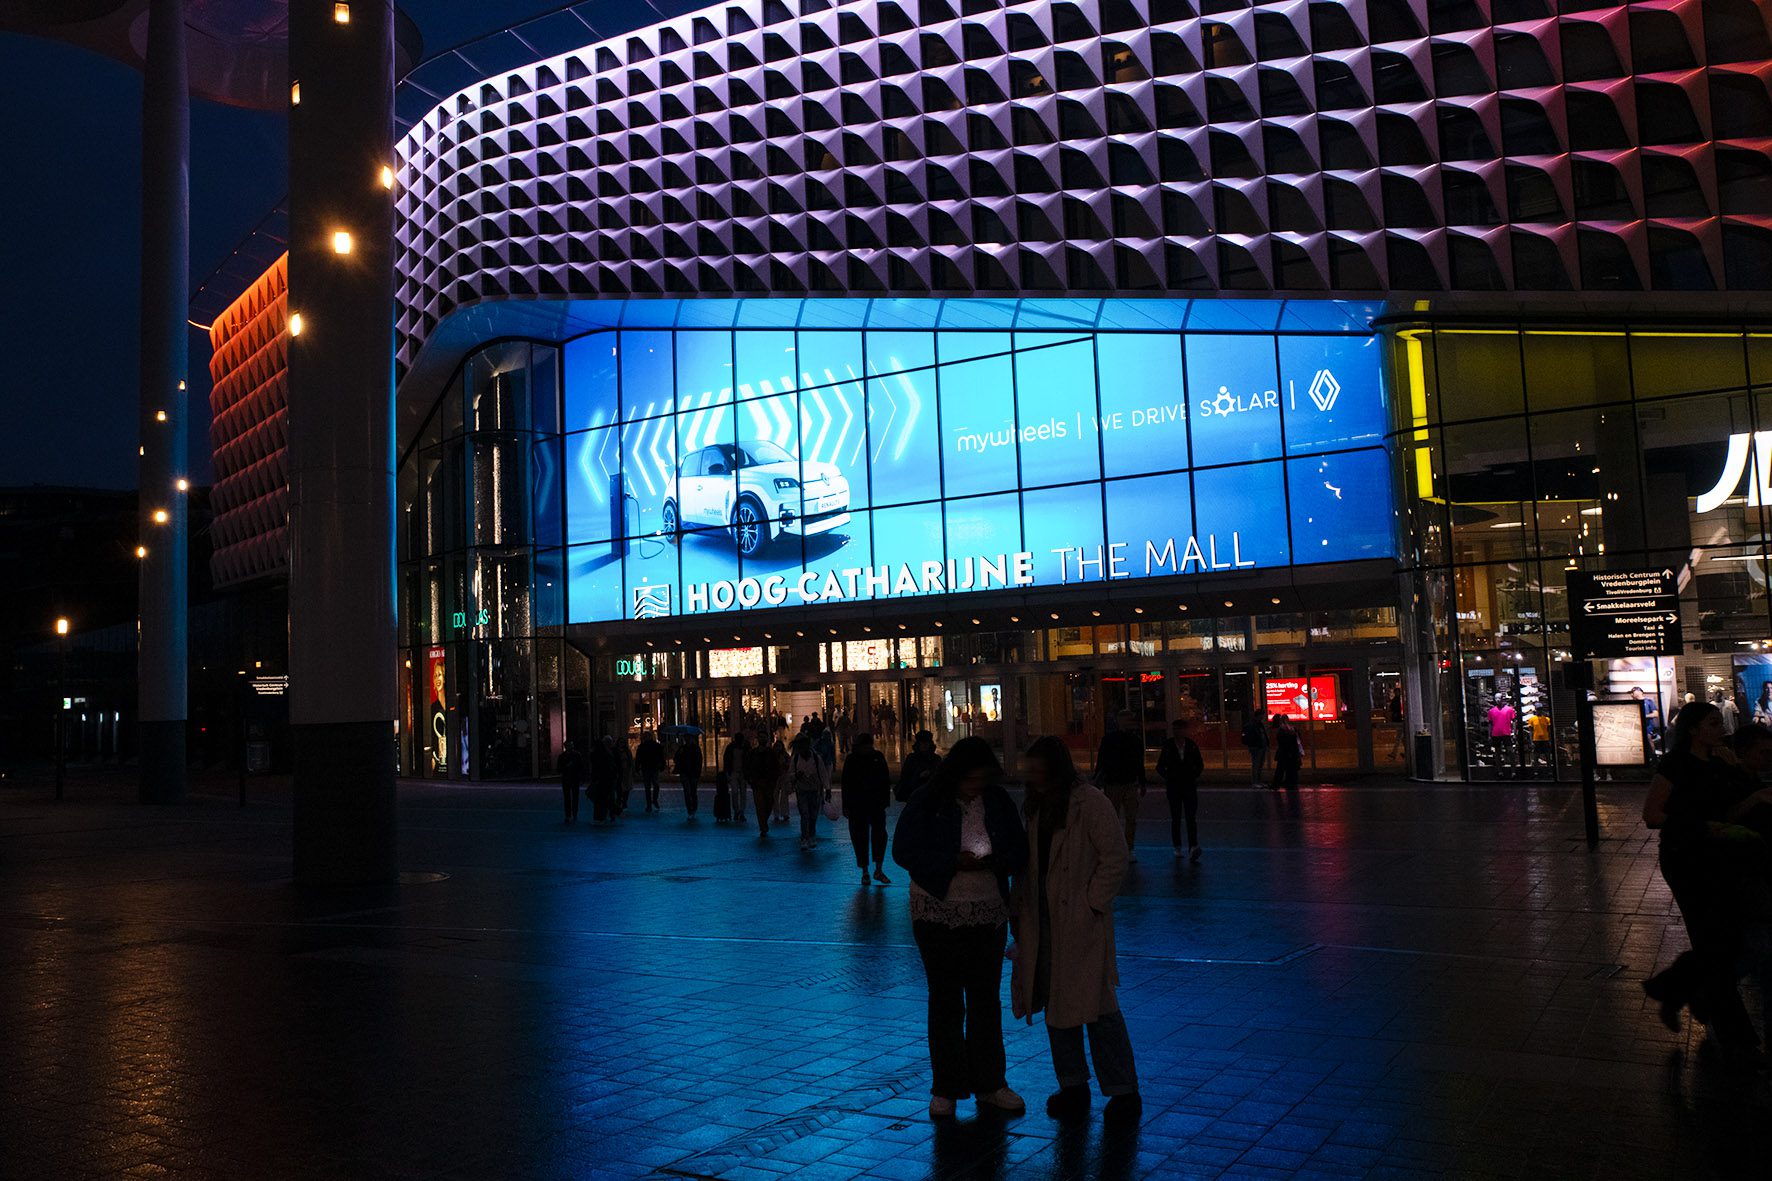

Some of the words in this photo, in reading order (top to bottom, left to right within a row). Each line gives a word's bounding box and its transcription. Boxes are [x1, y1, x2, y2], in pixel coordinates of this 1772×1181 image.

[1091, 412, 1123, 433] WE
[1132, 402, 1188, 427] DRIVE
[1200, 387, 1280, 418] SOLAR
[957, 417, 1067, 453] mywheels
[1050, 542, 1130, 581] THE
[1145, 531, 1257, 576] MALL
[1593, 572, 1628, 581] Historisch
[1629, 571, 1661, 579] Centrum
[1600, 578, 1661, 588] Vredenburgplein
[1596, 600, 1656, 610] Smakkelaarsveld
[453, 608, 489, 628] DOULAS
[1615, 615, 1664, 624] Moreelsepark
[616, 659, 656, 675] DOUGL
